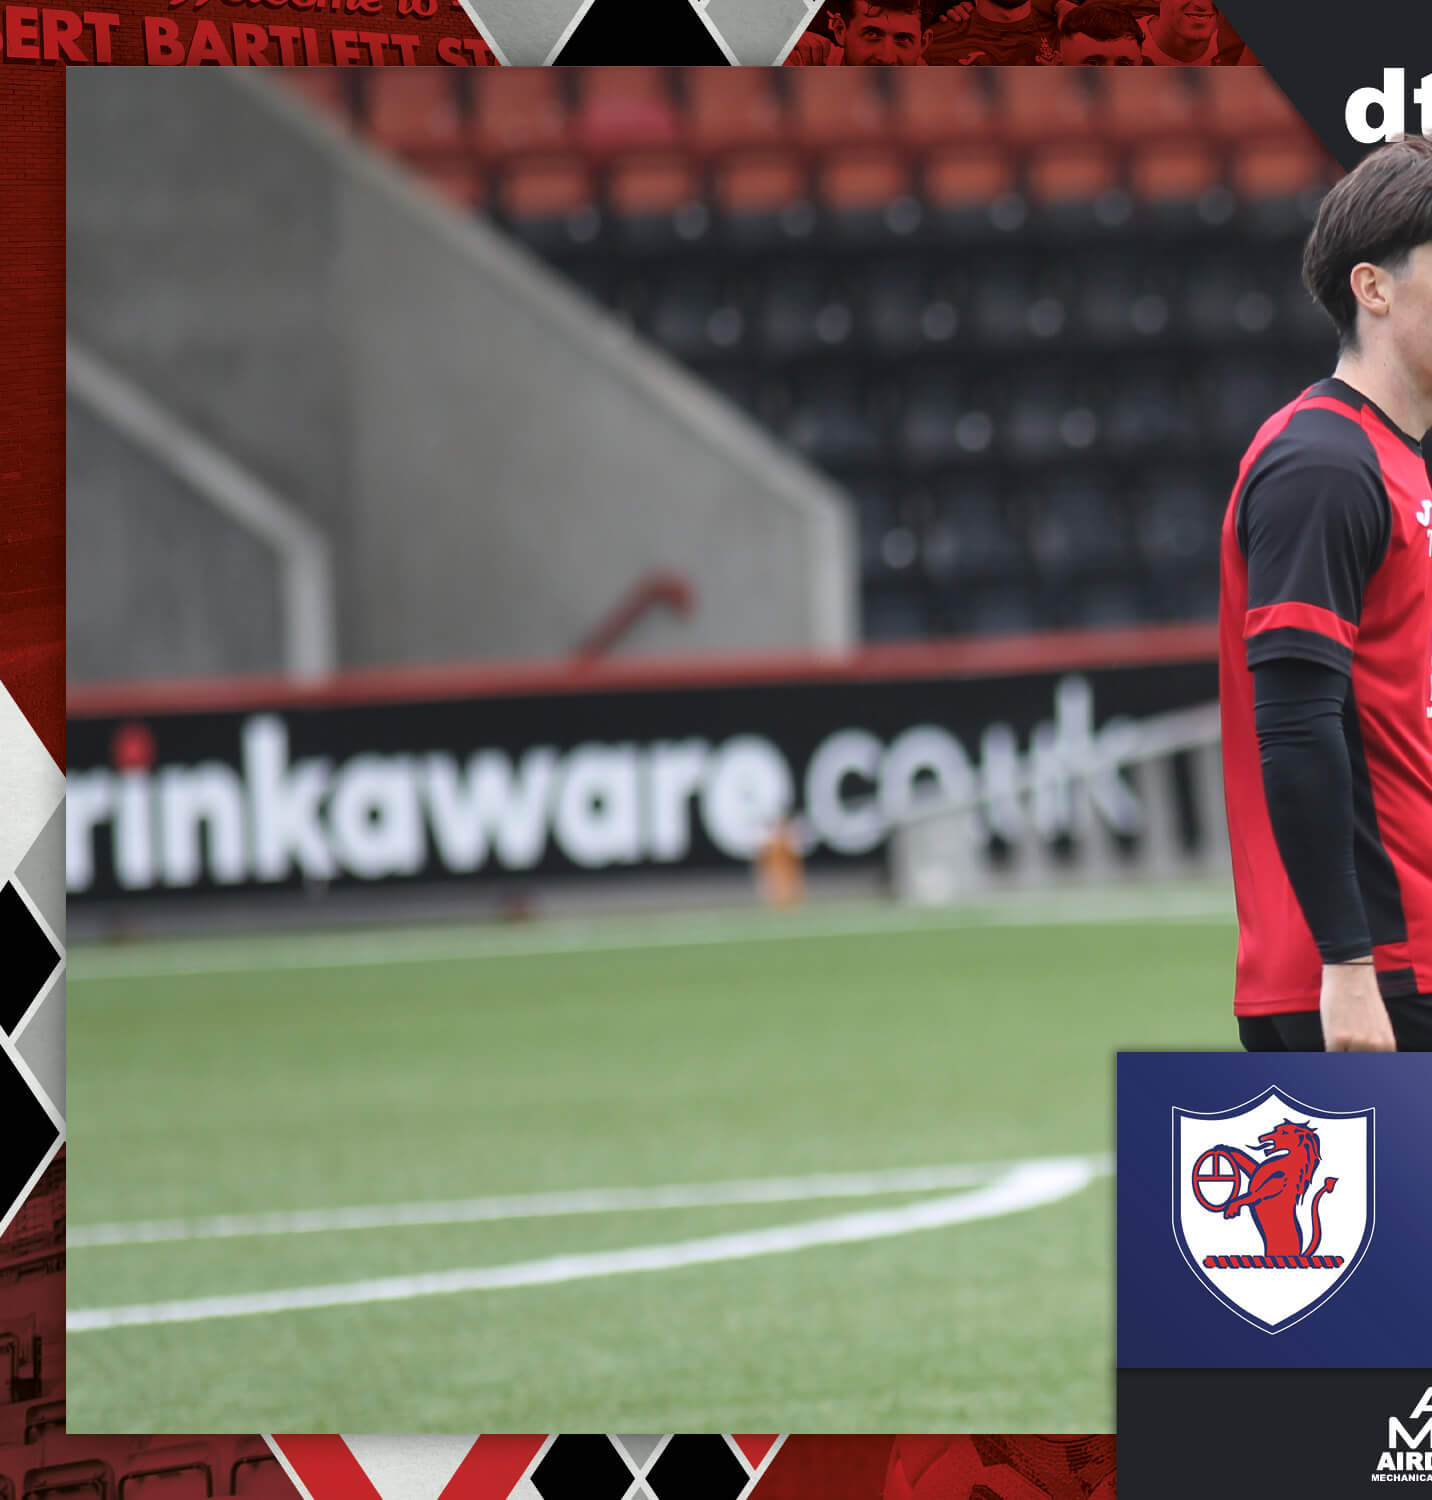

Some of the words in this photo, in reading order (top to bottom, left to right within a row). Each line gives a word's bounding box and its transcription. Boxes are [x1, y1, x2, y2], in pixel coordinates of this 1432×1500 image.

[0, 6, 120, 63] ERT
[145, 16, 420, 66] BARTLETT
[438, 37, 500, 66] ST
